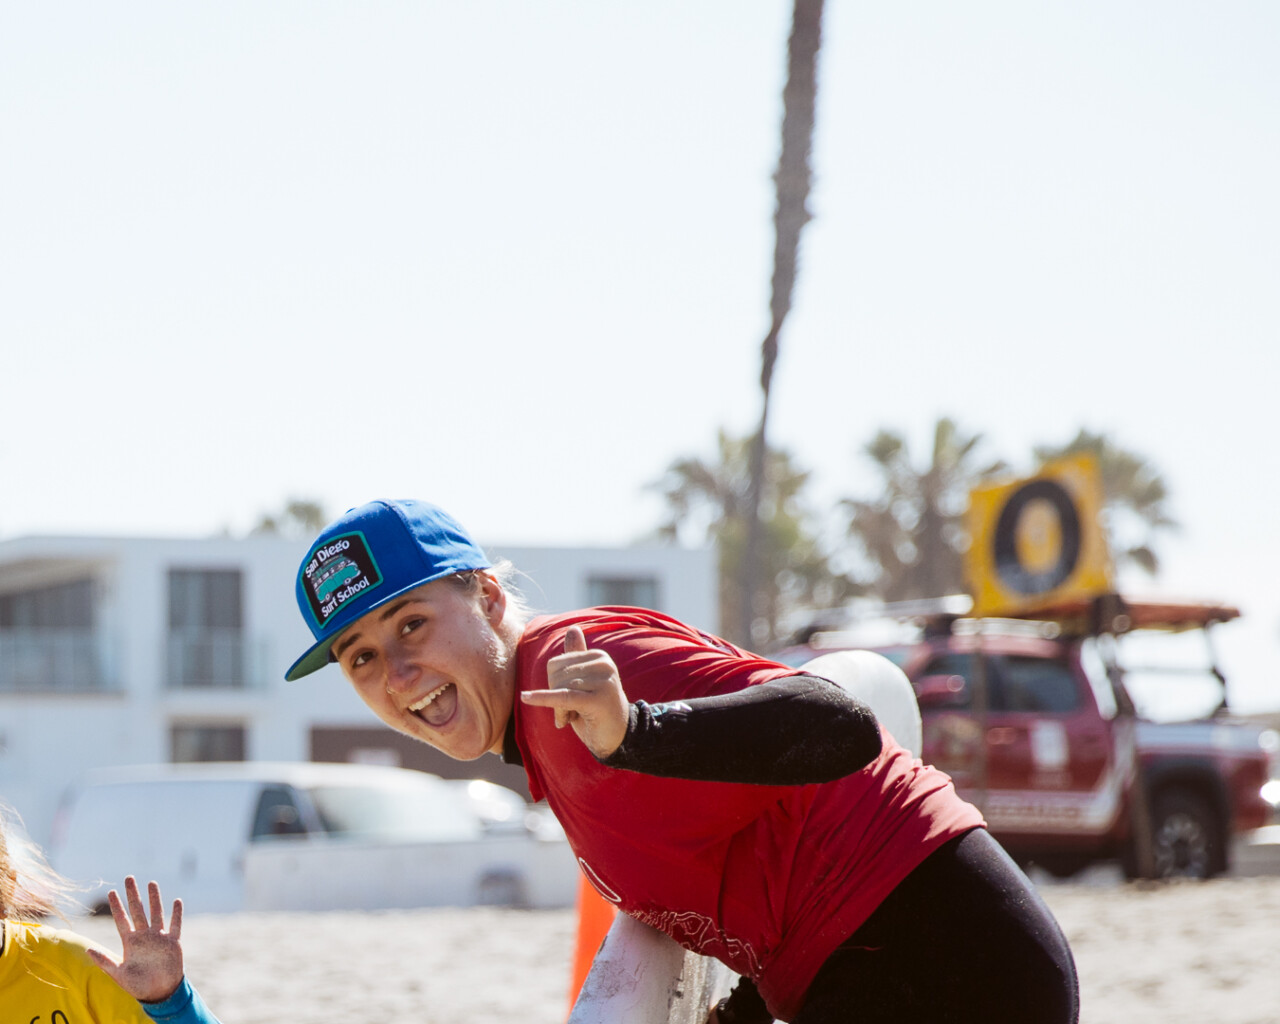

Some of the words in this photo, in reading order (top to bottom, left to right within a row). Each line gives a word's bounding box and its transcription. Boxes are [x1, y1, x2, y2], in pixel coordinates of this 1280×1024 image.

[305, 559, 319, 578] San
[317, 540, 350, 562] Diego
[321, 596, 338, 617] Surf
[336, 576, 370, 602] School
